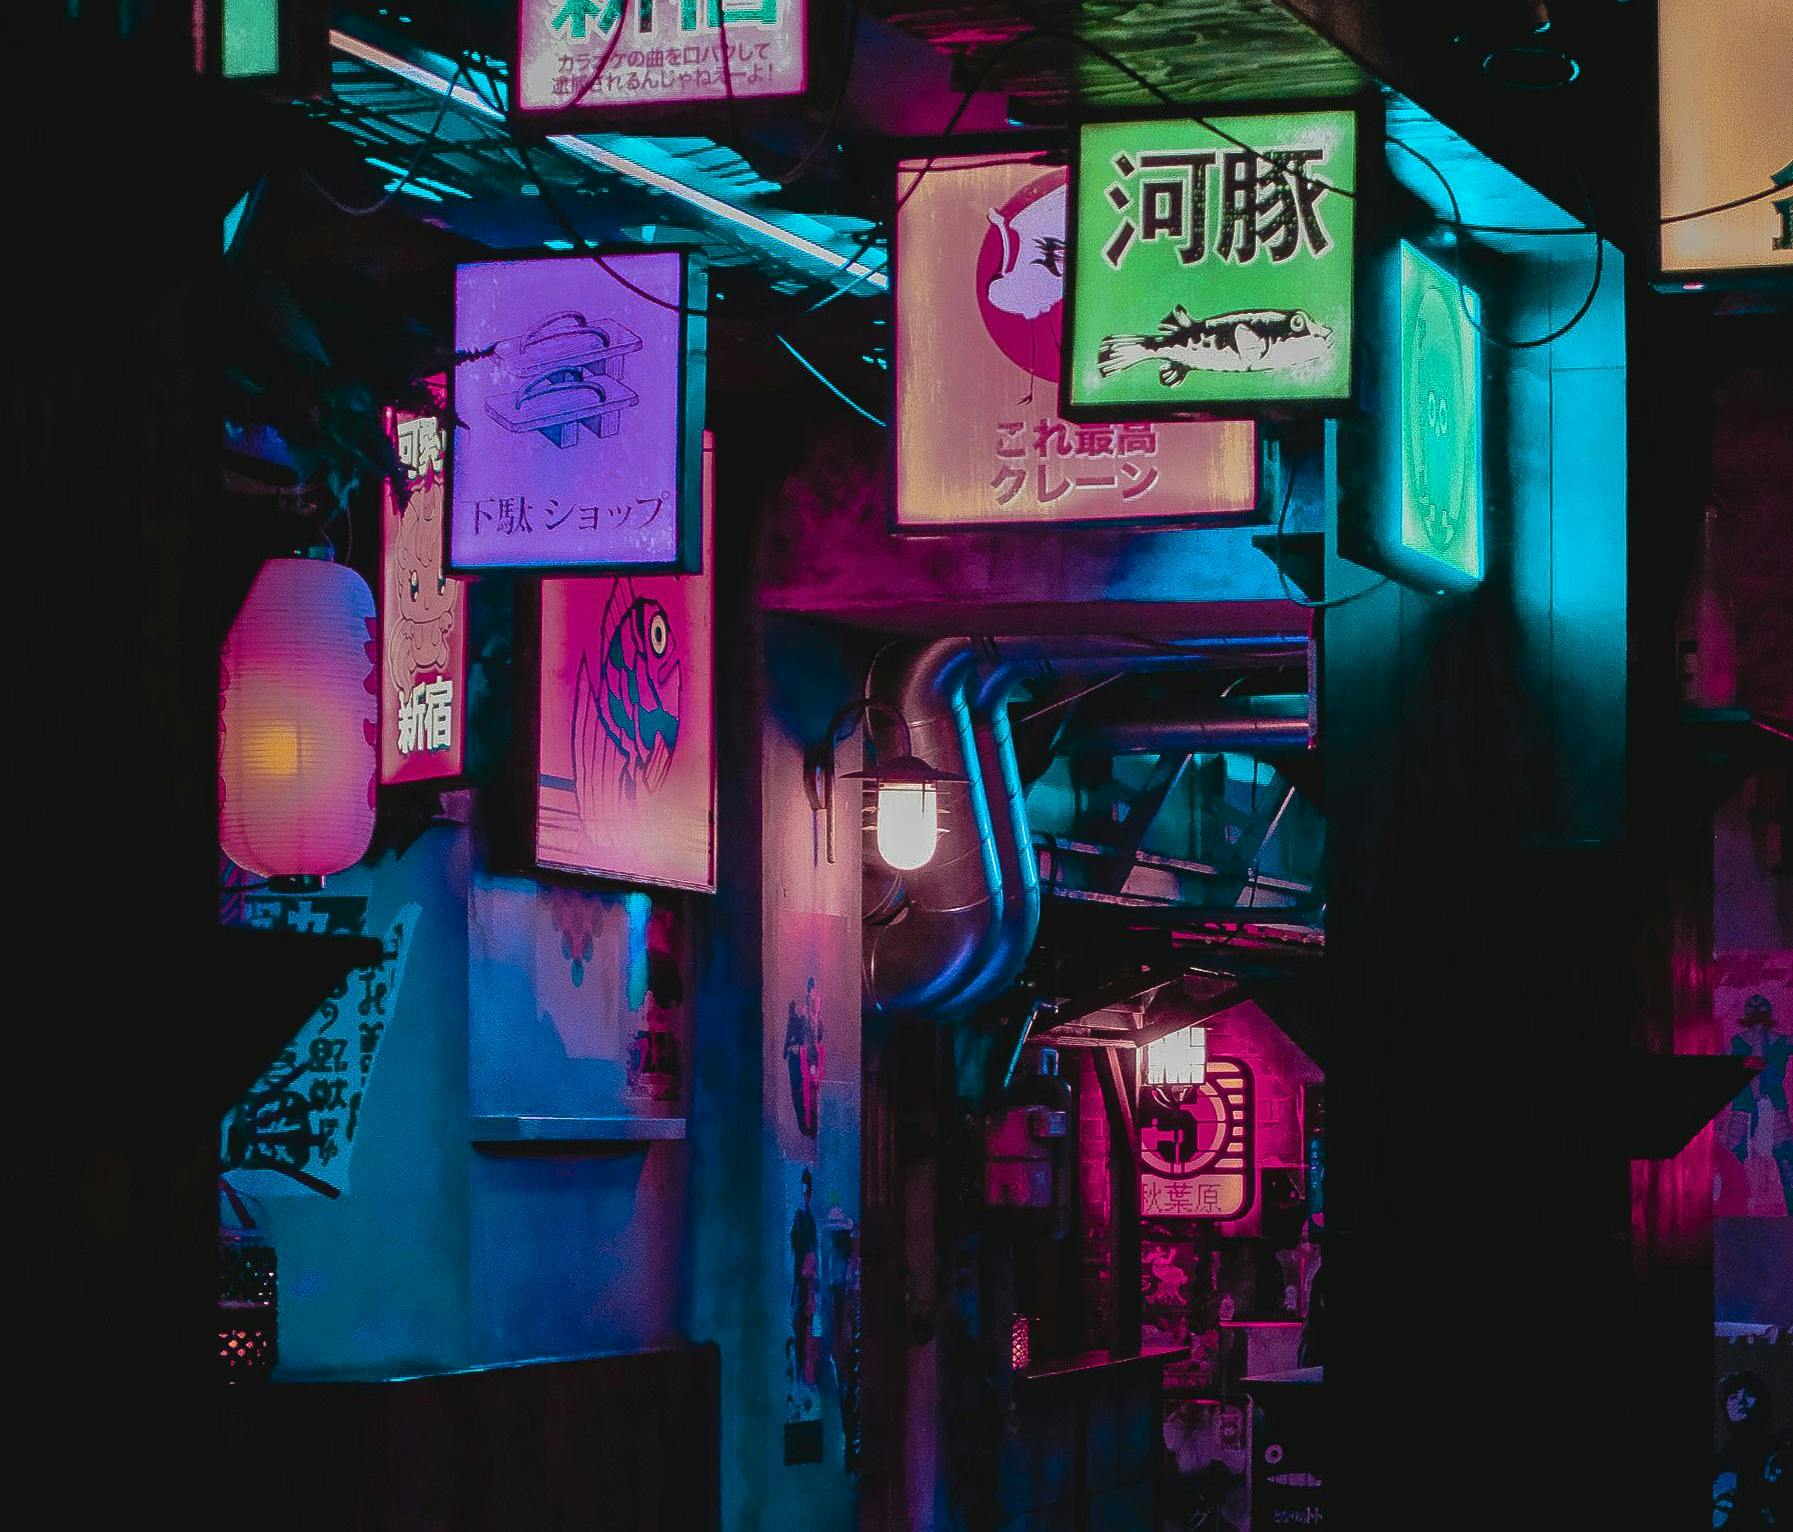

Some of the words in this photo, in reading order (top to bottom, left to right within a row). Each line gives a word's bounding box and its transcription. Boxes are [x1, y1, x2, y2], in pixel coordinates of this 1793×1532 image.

[1103, 148, 1331, 268] 河豚
[996, 418, 1158, 457] これ最高
[990, 463, 1158, 505] クレーン
[397, 675, 453, 754] 新宿
